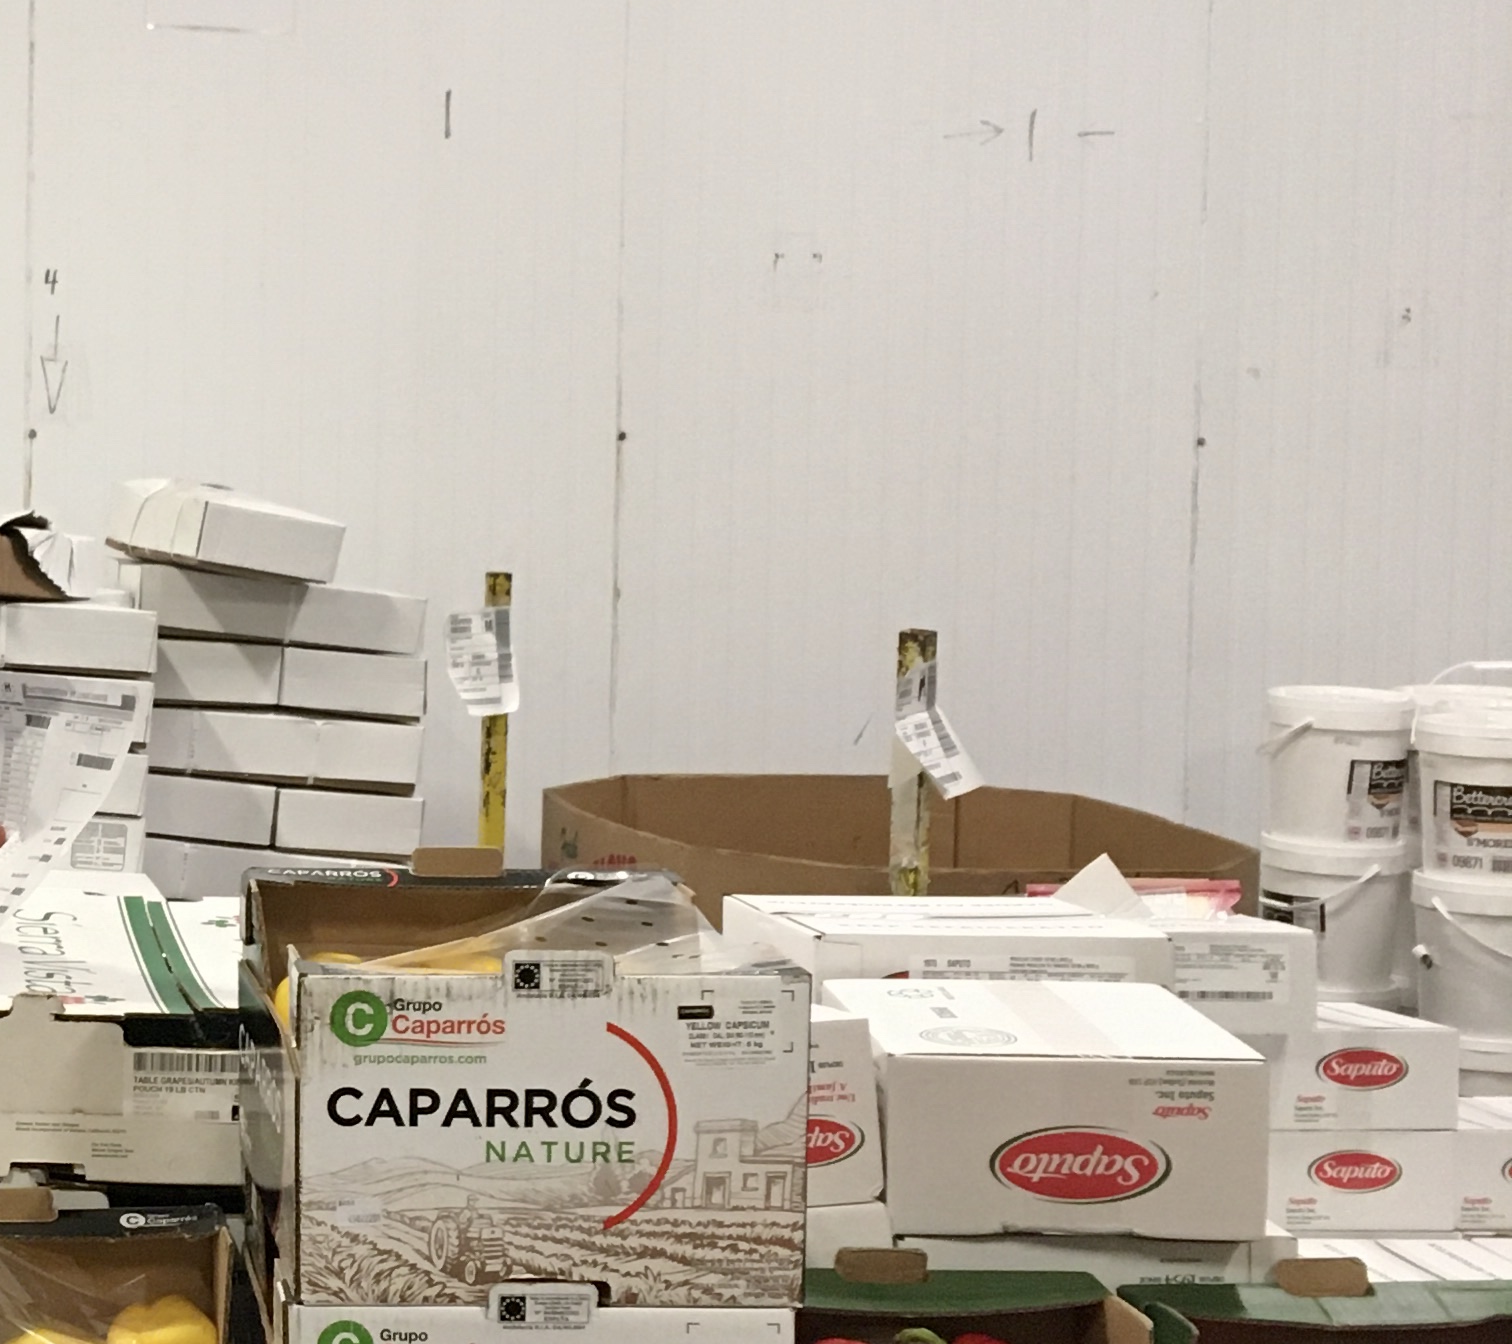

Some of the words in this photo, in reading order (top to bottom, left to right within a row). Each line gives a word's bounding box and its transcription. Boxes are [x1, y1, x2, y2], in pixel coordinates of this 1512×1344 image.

[393, 999, 442, 1014] Grupo
[391, 1014, 505, 1037] Caparrós
[354, 1053, 487, 1067] grupocaparros.com
[1327, 1058, 1400, 1080] Saputo
[327, 1078, 636, 1128] CAPARRÓS
[486, 1141, 635, 1162] NATURE
[1006, 1143, 1150, 1186] Saputo
[1319, 1160, 1393, 1183] Saputo
[380, 1329, 428, 1344] Grupo
